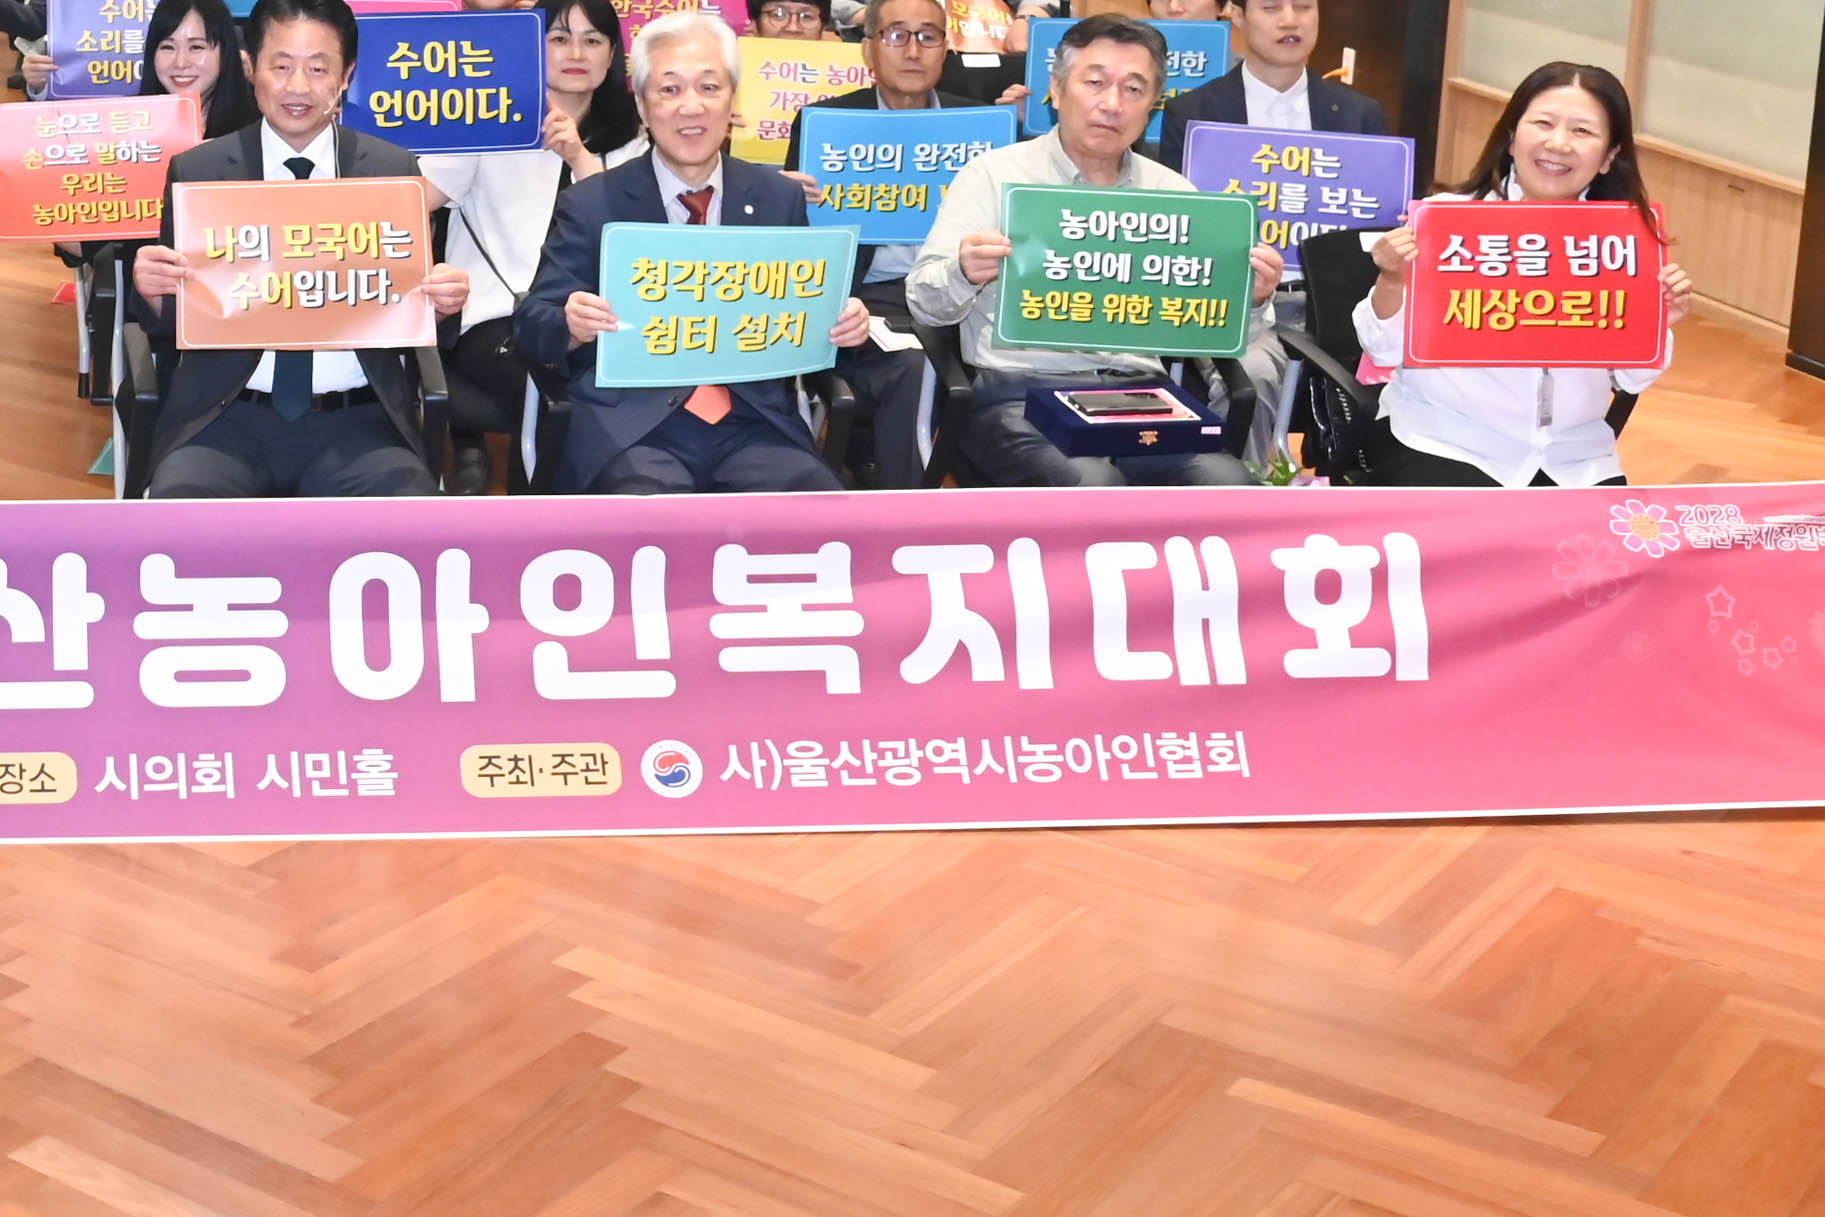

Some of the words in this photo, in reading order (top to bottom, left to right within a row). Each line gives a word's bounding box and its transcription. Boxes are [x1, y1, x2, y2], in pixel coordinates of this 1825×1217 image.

[75, 29, 146, 54] 소리를
[387, 40, 495, 80] 수어는
[758, 61, 819, 84] 수어는
[369, 86, 523, 128] 언어이다.
[769, 90, 812, 113] 가장
[36, 112, 102, 138] 눈으로
[110, 110, 152, 133] 듣고
[23, 143, 89, 170] 손으로
[95, 140, 163, 166] 말하는
[820, 142, 905, 172] 농인의
[1251, 144, 1343, 179] 수어는
[60, 171, 128, 196] 우리는
[818, 184, 928, 213] 사회참여
[1318, 185, 1381, 220] 보는
[203, 224, 271, 263] 나의
[281, 221, 414, 260] 모국어는
[1059, 209, 1191, 245] 농아인의!
[1043, 249, 1132, 284] 농인에
[1141, 254, 1213, 287] 의한!
[1437, 234, 1552, 277] 소통을
[1563, 234, 1638, 278] 넘어
[230, 268, 402, 311] 수어입니다.
[629, 257, 827, 303] 청각장애인
[1019, 289, 1095, 322] 농인을
[1102, 293, 1153, 325] 위한
[1159, 296, 1229, 328] 복지!!
[1442, 288, 1627, 331] 세상으로!!
[642, 314, 718, 356] 쉼터
[732, 310, 807, 352] 설치
[1674, 504, 1745, 527] 2028
[94, 751, 235, 802] 시의회
[255, 747, 400, 798] 시민홀
[475, 751, 610, 789] 주최·주관
[719, 730, 1251, 791] 사)울산광역시농아인협회
